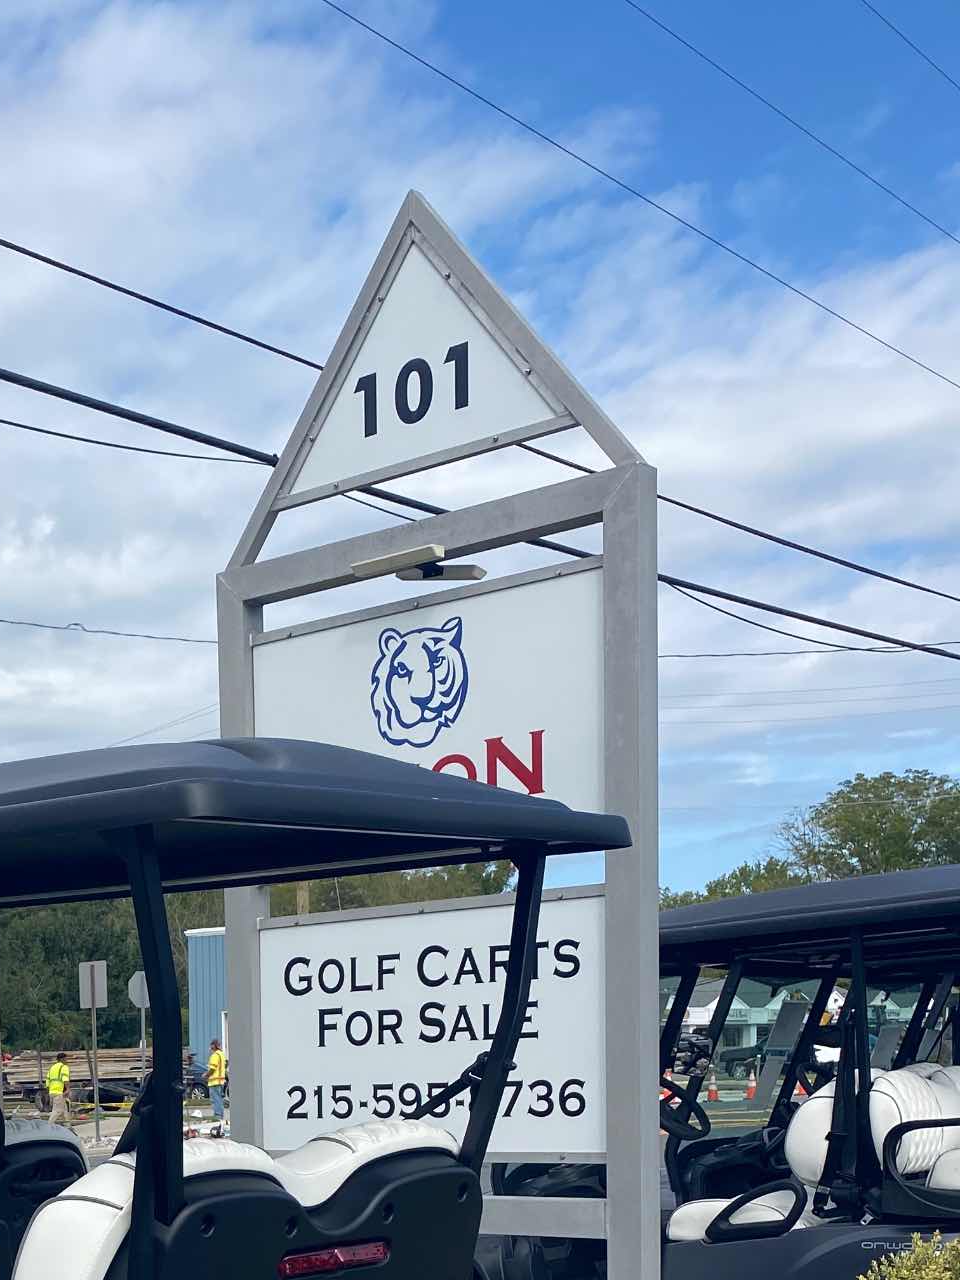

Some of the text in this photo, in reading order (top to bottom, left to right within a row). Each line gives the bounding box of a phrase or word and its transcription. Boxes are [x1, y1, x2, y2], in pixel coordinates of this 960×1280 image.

[353, 341, 469, 438] 101
[284, 938, 580, 996] GOLF CARTS
[318, 1007, 403, 1047] FOR
[286, 1078, 586, 1120] 215-595-736
